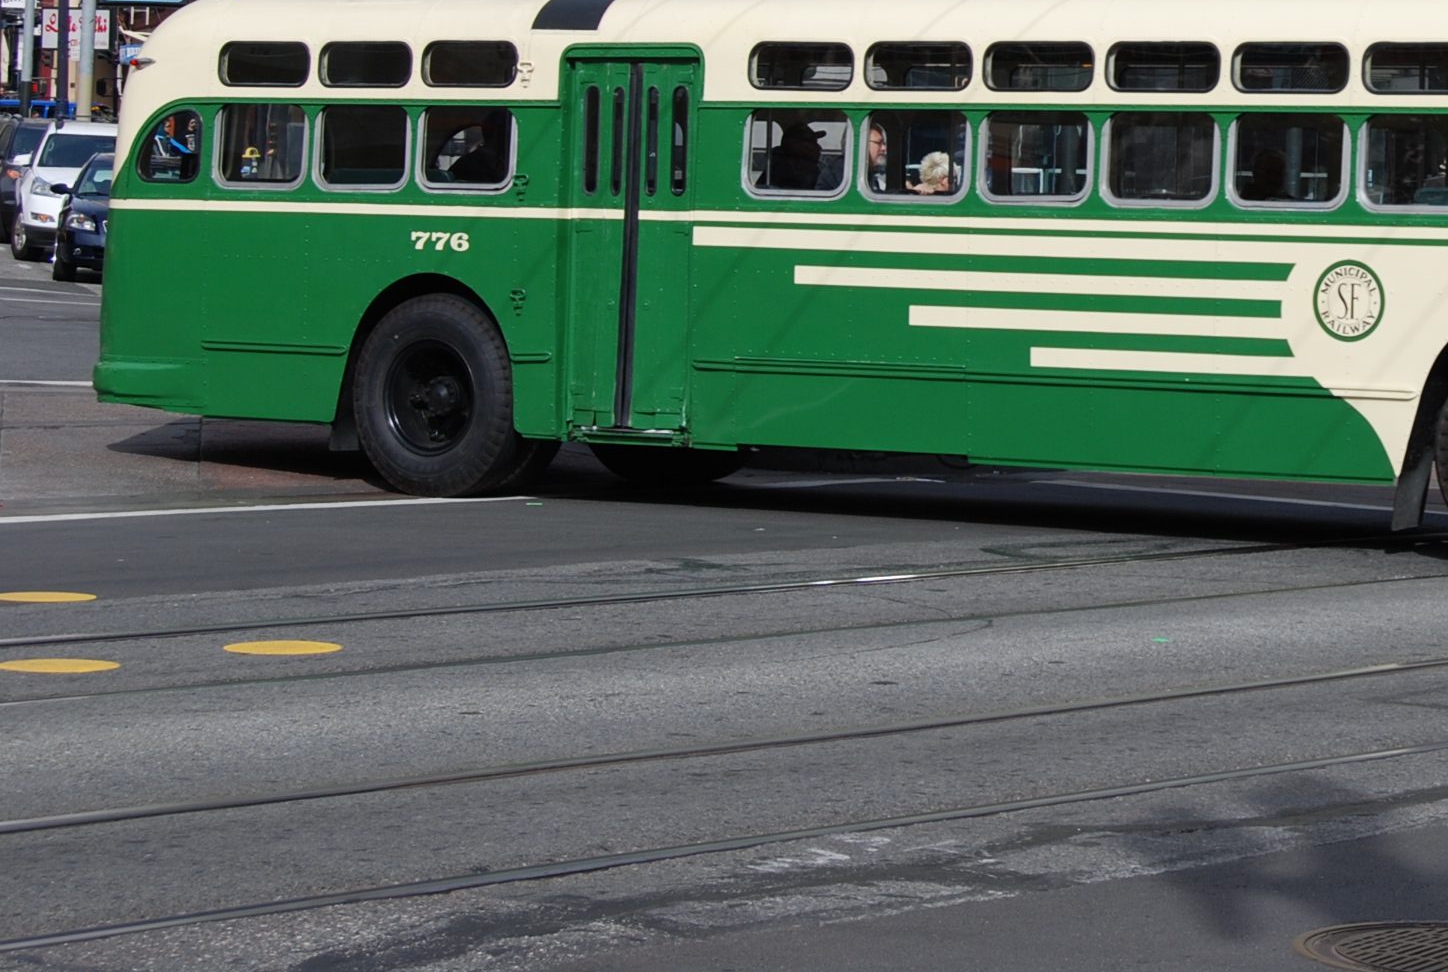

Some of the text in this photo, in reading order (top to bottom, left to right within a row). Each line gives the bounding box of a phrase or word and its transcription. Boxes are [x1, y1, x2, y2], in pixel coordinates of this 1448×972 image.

[410, 231, 470, 251] 776
[1321, 267, 1377, 296] MUNICIPAL
[1321, 310, 1376, 334] RAILWAY
